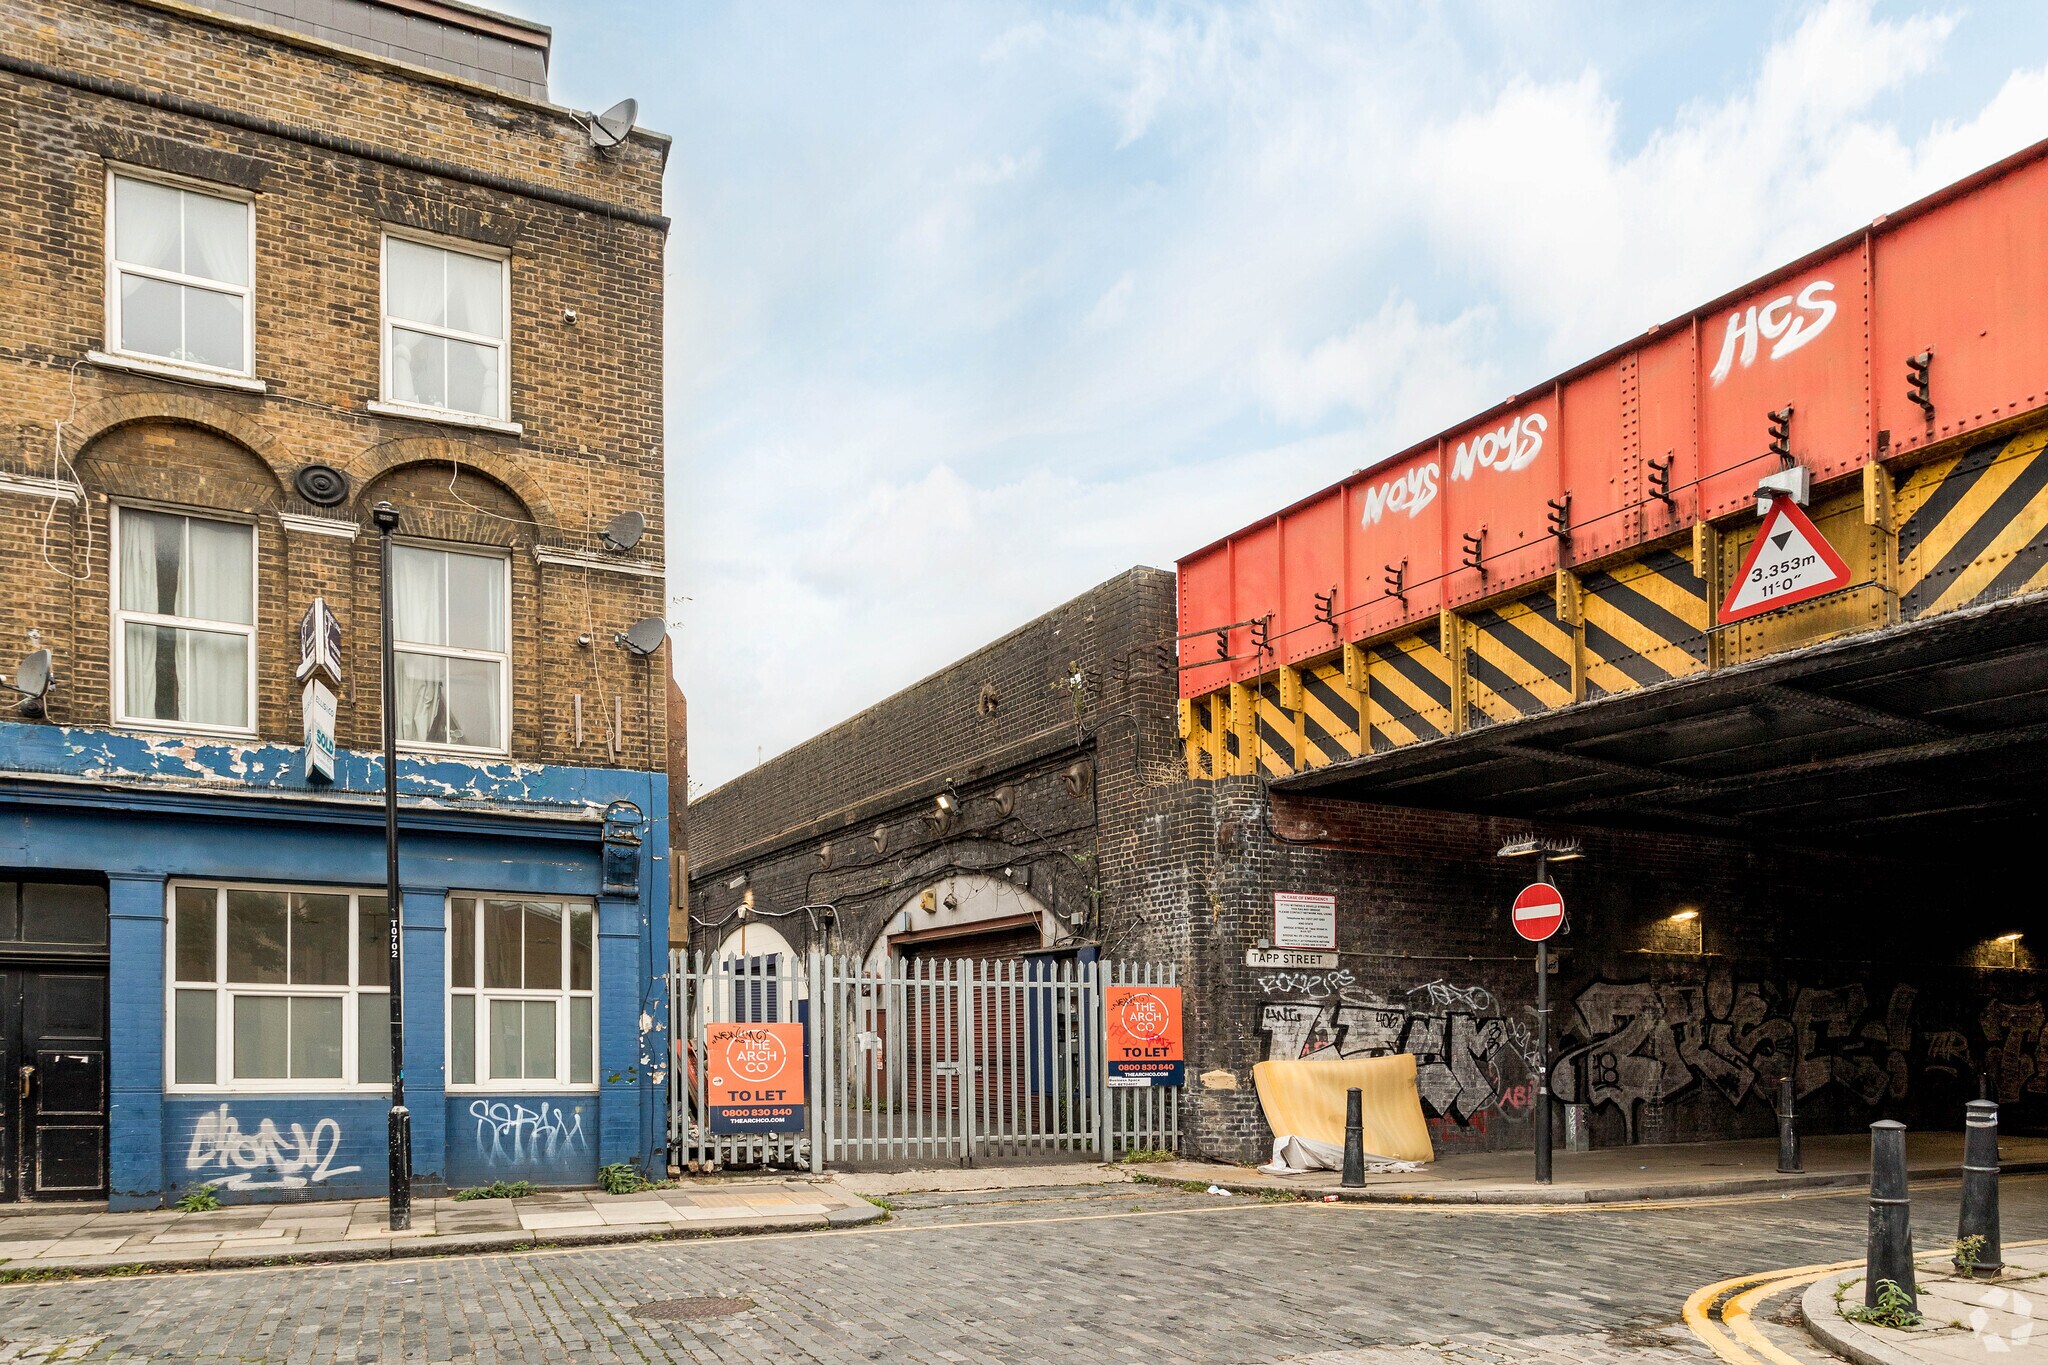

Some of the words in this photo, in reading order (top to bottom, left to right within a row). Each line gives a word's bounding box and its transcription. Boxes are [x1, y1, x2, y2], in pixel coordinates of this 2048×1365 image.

[1710, 281, 1837, 388] HCS
[1451, 413, 1548, 481] NOYS
[1751, 555, 1816, 583] 3.353m
[316, 729, 334, 755] SOLD
[1252, 953, 1279, 964] TAPP
[1283, 954, 1323, 965] STREET
[1134, 1002, 1156, 1011] THE
[1129, 1012, 1162, 1021] ARCH
[1136, 1022, 1155, 1031] CO
[744, 1039, 771, 1050] THE
[736, 1051, 777, 1061] ARCH
[1123, 1047, 1142, 1057] TO
[1145, 1047, 1169, 1057] LET
[745, 1062, 768, 1073] CO
[1158, 1063, 1175, 1071] 840
[727, 1090, 751, 1101] TO
[755, 1090, 787, 1101] LET
[722, 1109, 750, 1117] 0800
[751, 1108, 771, 1117] 830
[772, 1108, 793, 1116] 840
